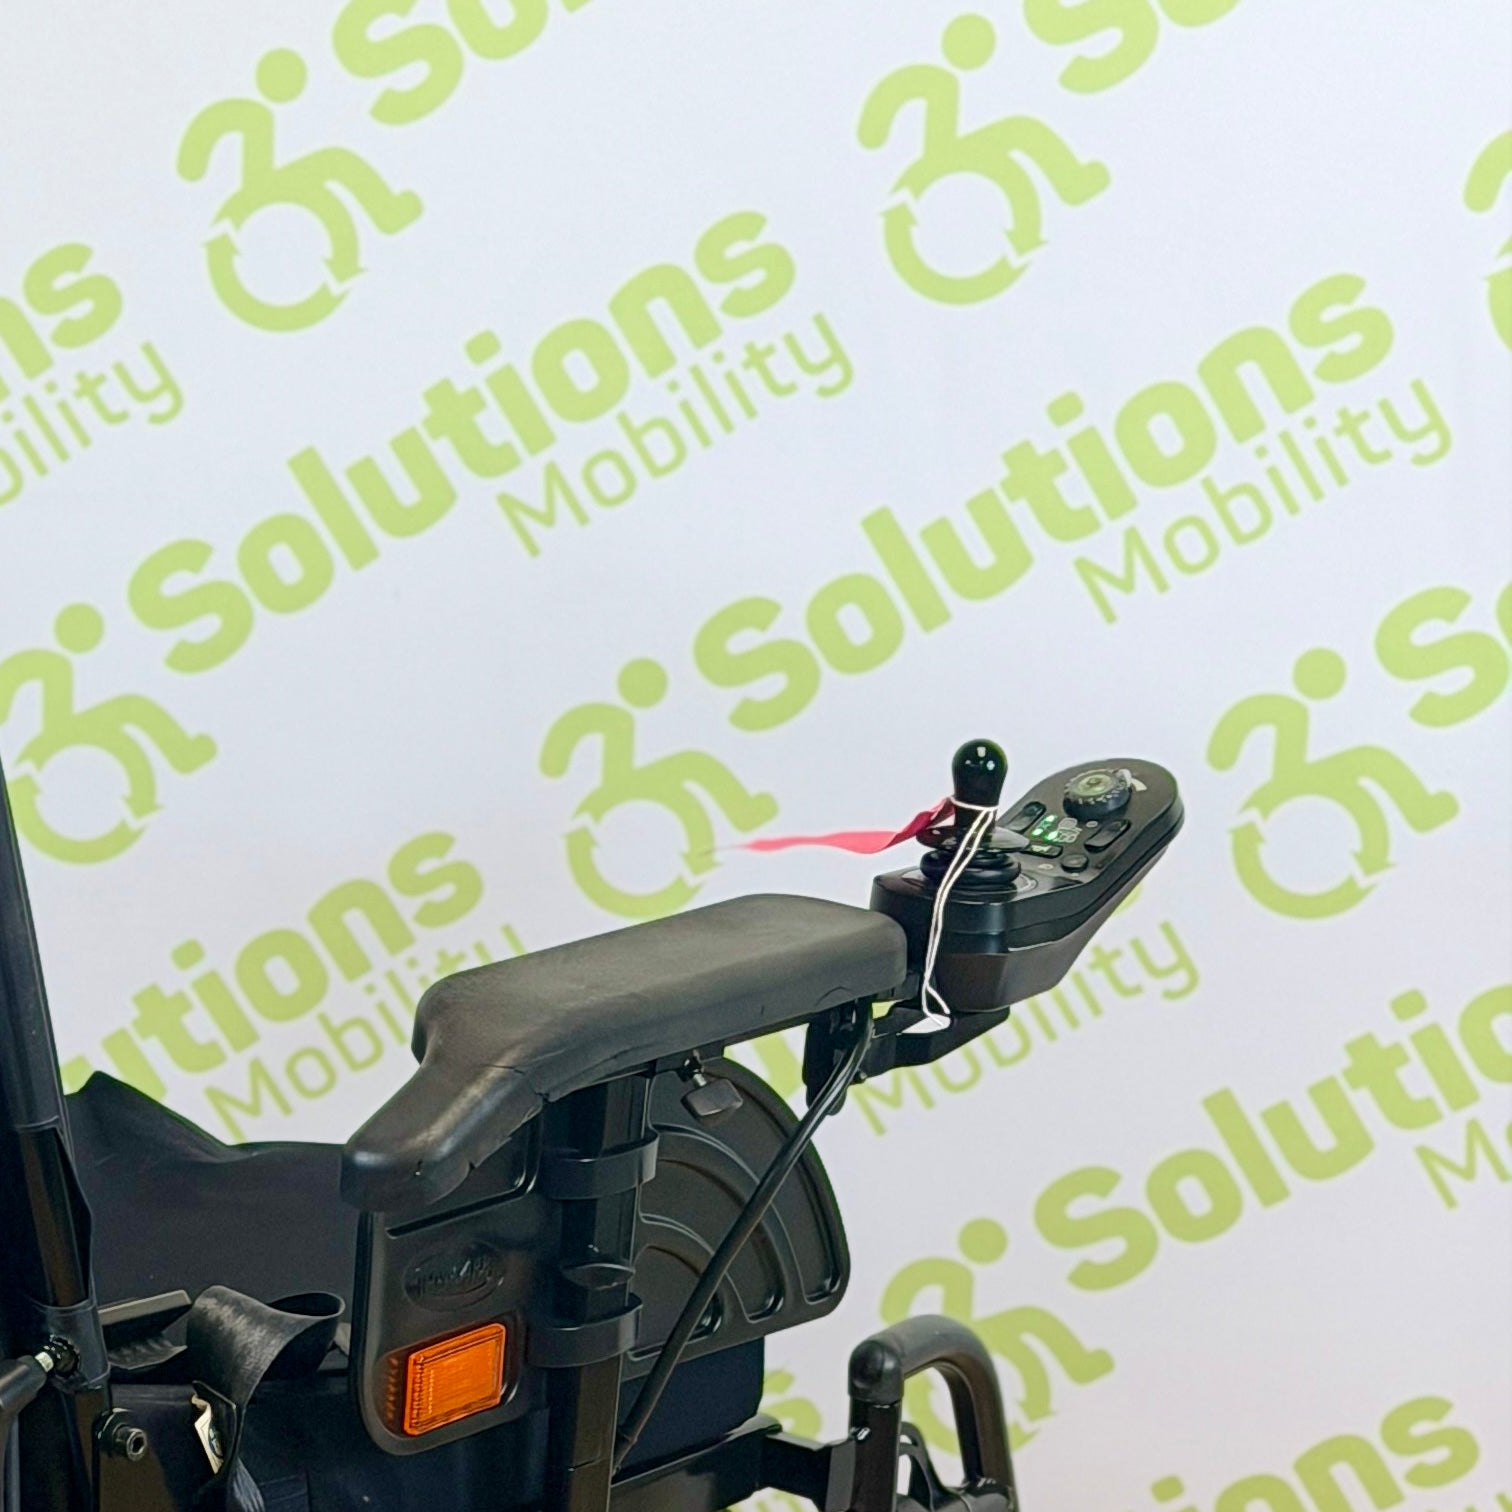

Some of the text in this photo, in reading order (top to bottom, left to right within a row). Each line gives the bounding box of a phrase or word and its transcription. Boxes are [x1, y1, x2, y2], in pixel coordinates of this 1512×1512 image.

[127, 212, 795, 674] Solutions
[497, 315, 853, 556] Mobility
[693, 274, 1393, 732] Solutions
[1075, 380, 1451, 623] Mobility
